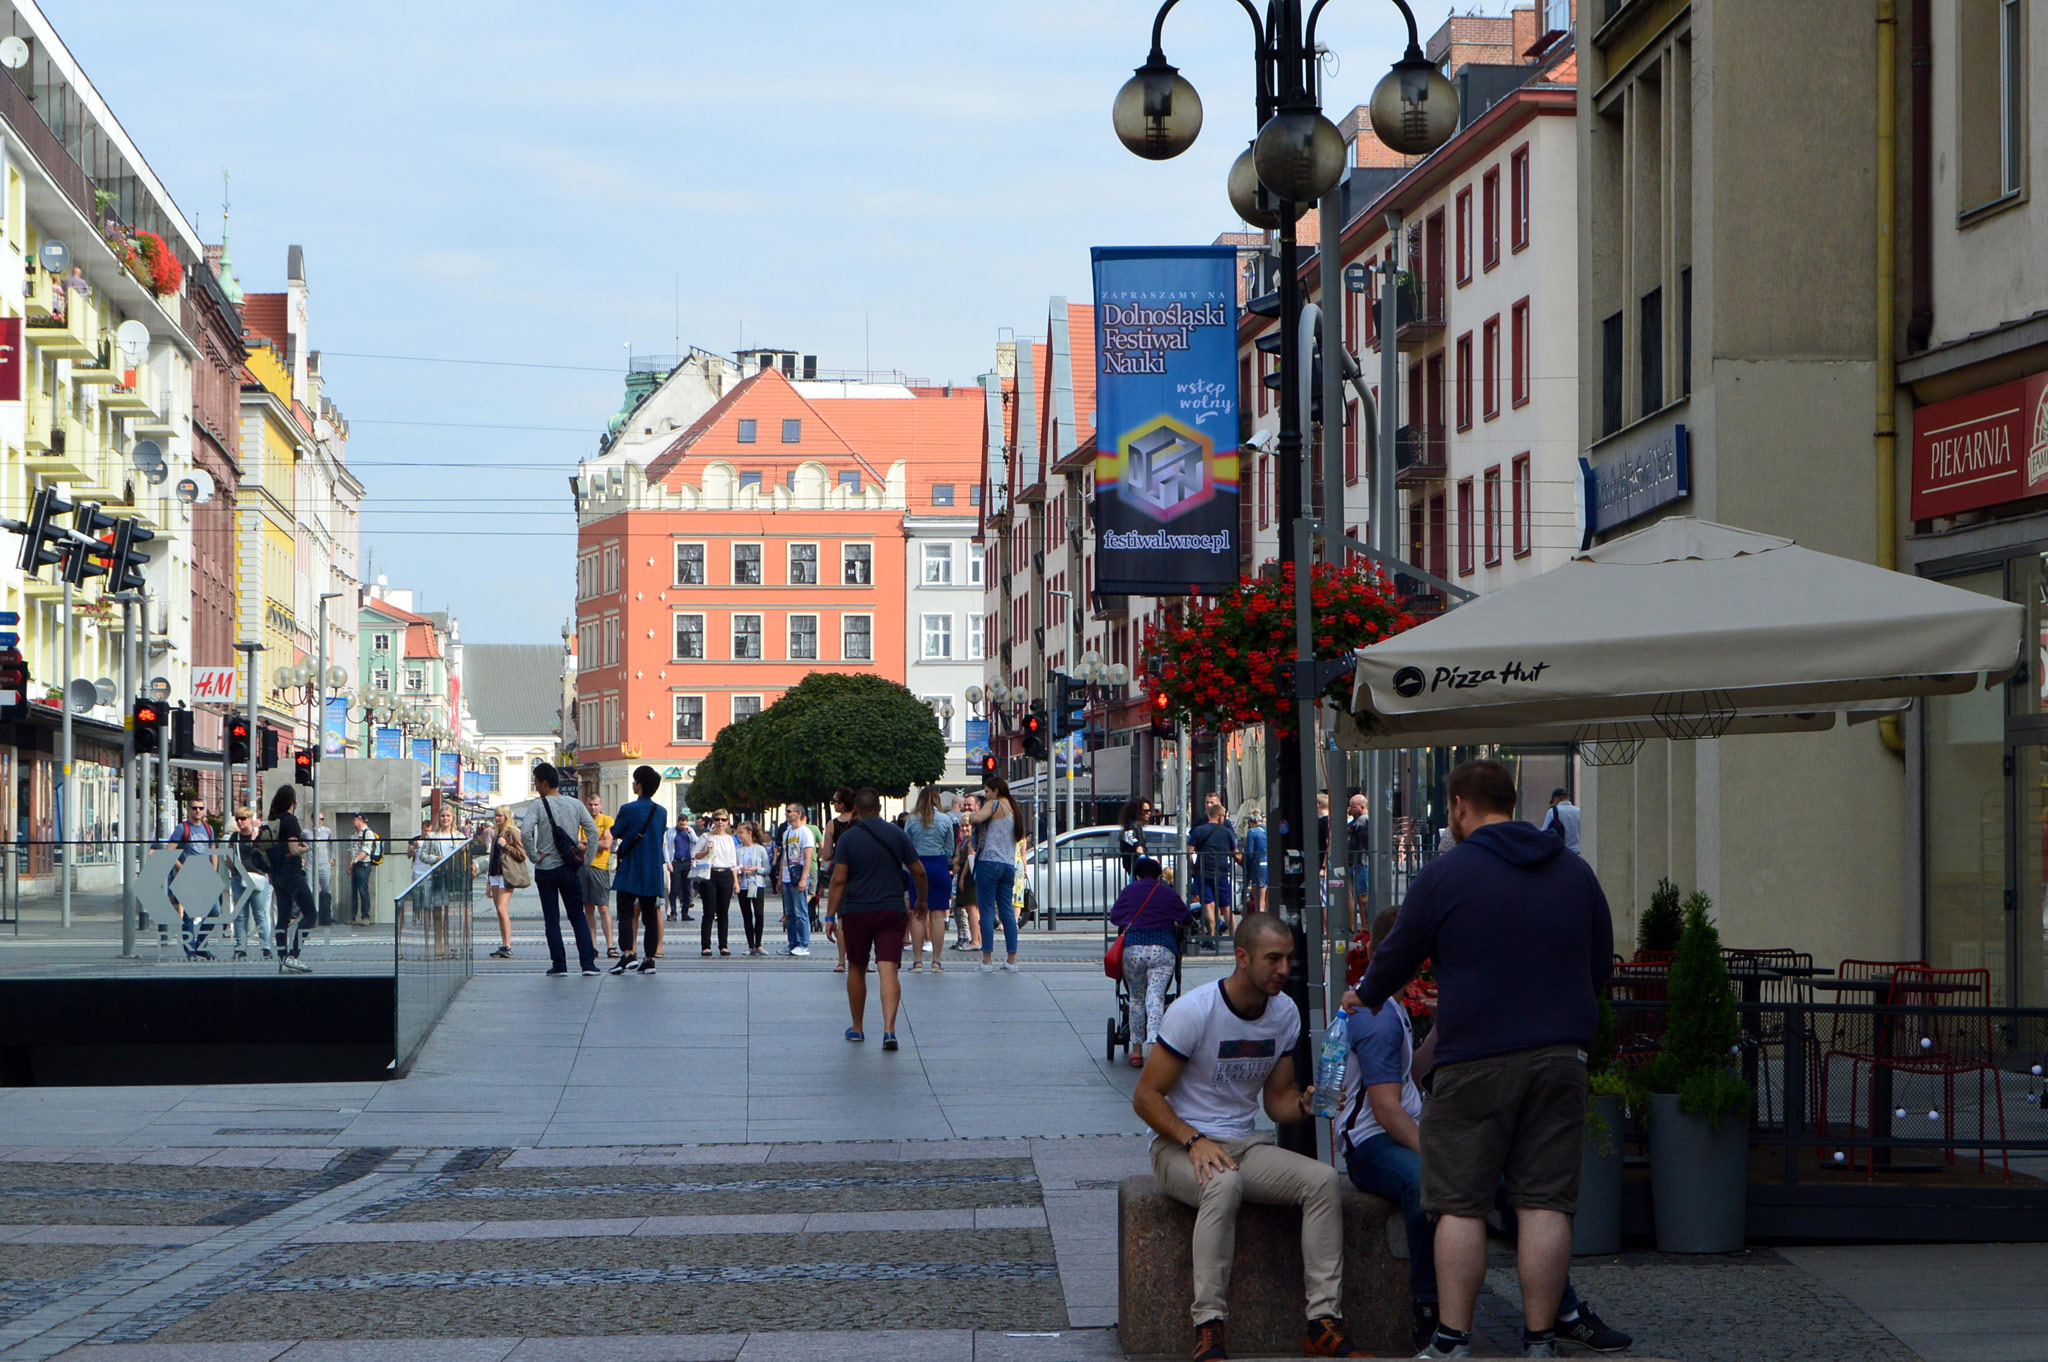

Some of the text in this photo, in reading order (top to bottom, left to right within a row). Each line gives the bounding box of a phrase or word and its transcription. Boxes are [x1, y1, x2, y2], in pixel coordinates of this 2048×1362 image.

[1101, 291, 1226, 300] ZAPRASZAMY NA
[1102, 301, 1227, 331] Dolnośląski
[1103, 326, 1190, 350] Festiwal
[1103, 350, 1166, 374] Nauki
[1176, 378, 1226, 399] wstęp
[1179, 394, 1235, 414] wolny
[1930, 424, 2011, 480] PIEKARNIA
[1103, 529, 1230, 553] festiwal.wroc.pl
[194, 671, 234, 698] H&M
[1430, 660, 1552, 693] Pizza Hut
